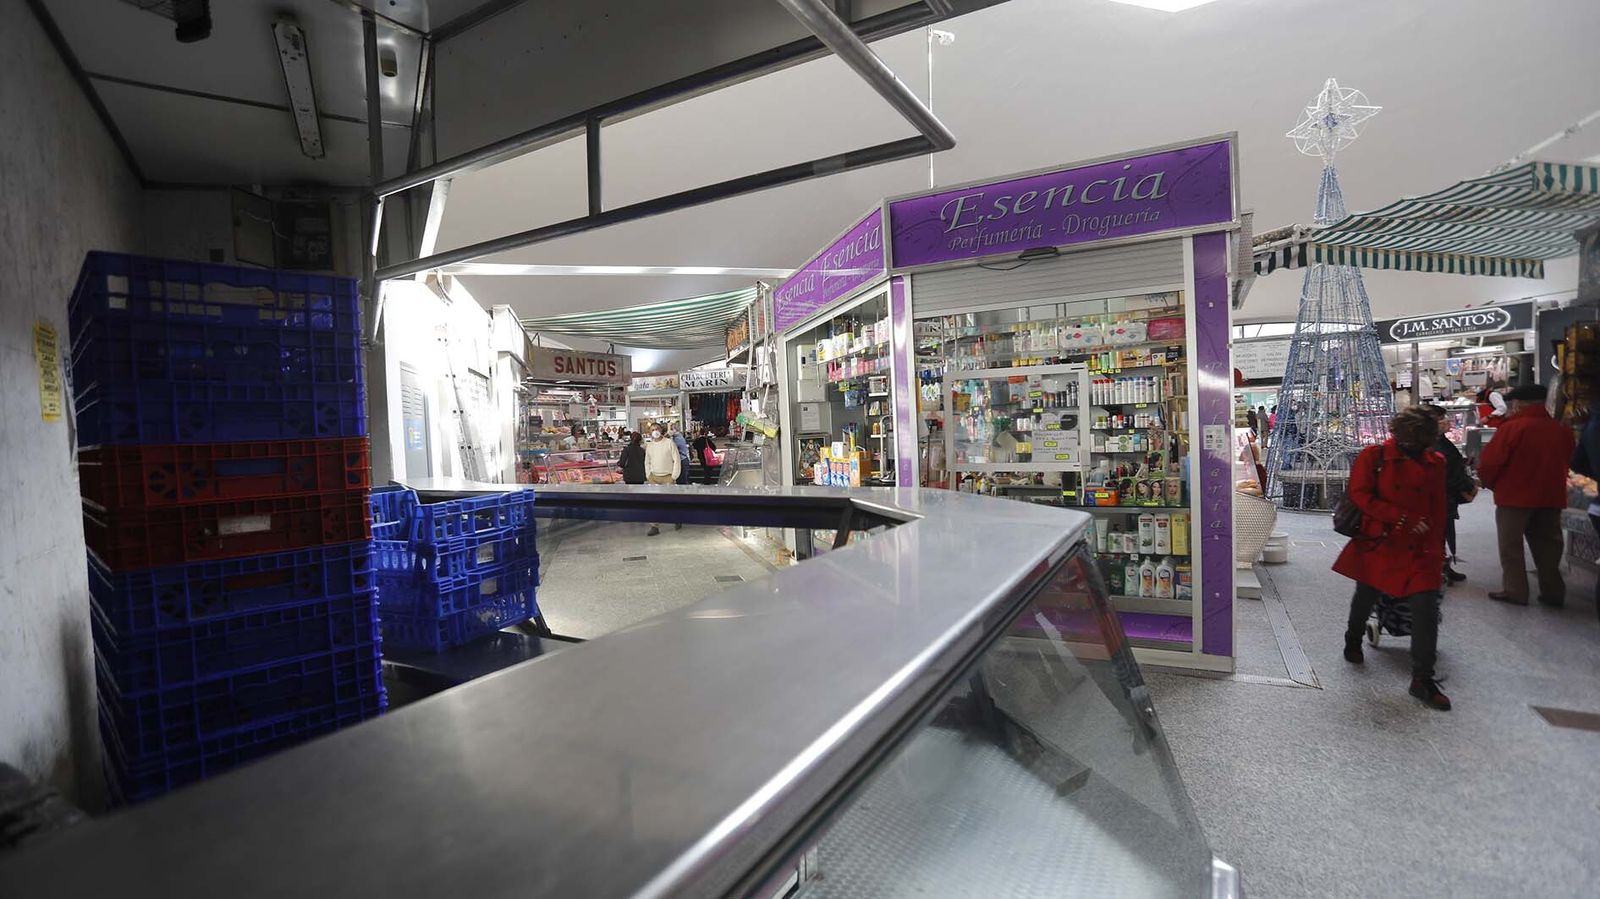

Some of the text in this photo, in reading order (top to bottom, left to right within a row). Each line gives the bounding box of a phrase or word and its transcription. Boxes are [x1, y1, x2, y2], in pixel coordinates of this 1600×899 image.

[940, 164, 1168, 233] Esencia
[947, 220, 1044, 252] Perfumería
[1062, 207, 1161, 237] Droguería
[821, 222, 881, 284] Esencia
[776, 271, 816, 314] Esencia
[1402, 312, 1496, 336] J.M. SANTOS
[554, 355, 617, 377] SANTOS
[684, 377, 729, 389] MARIN
